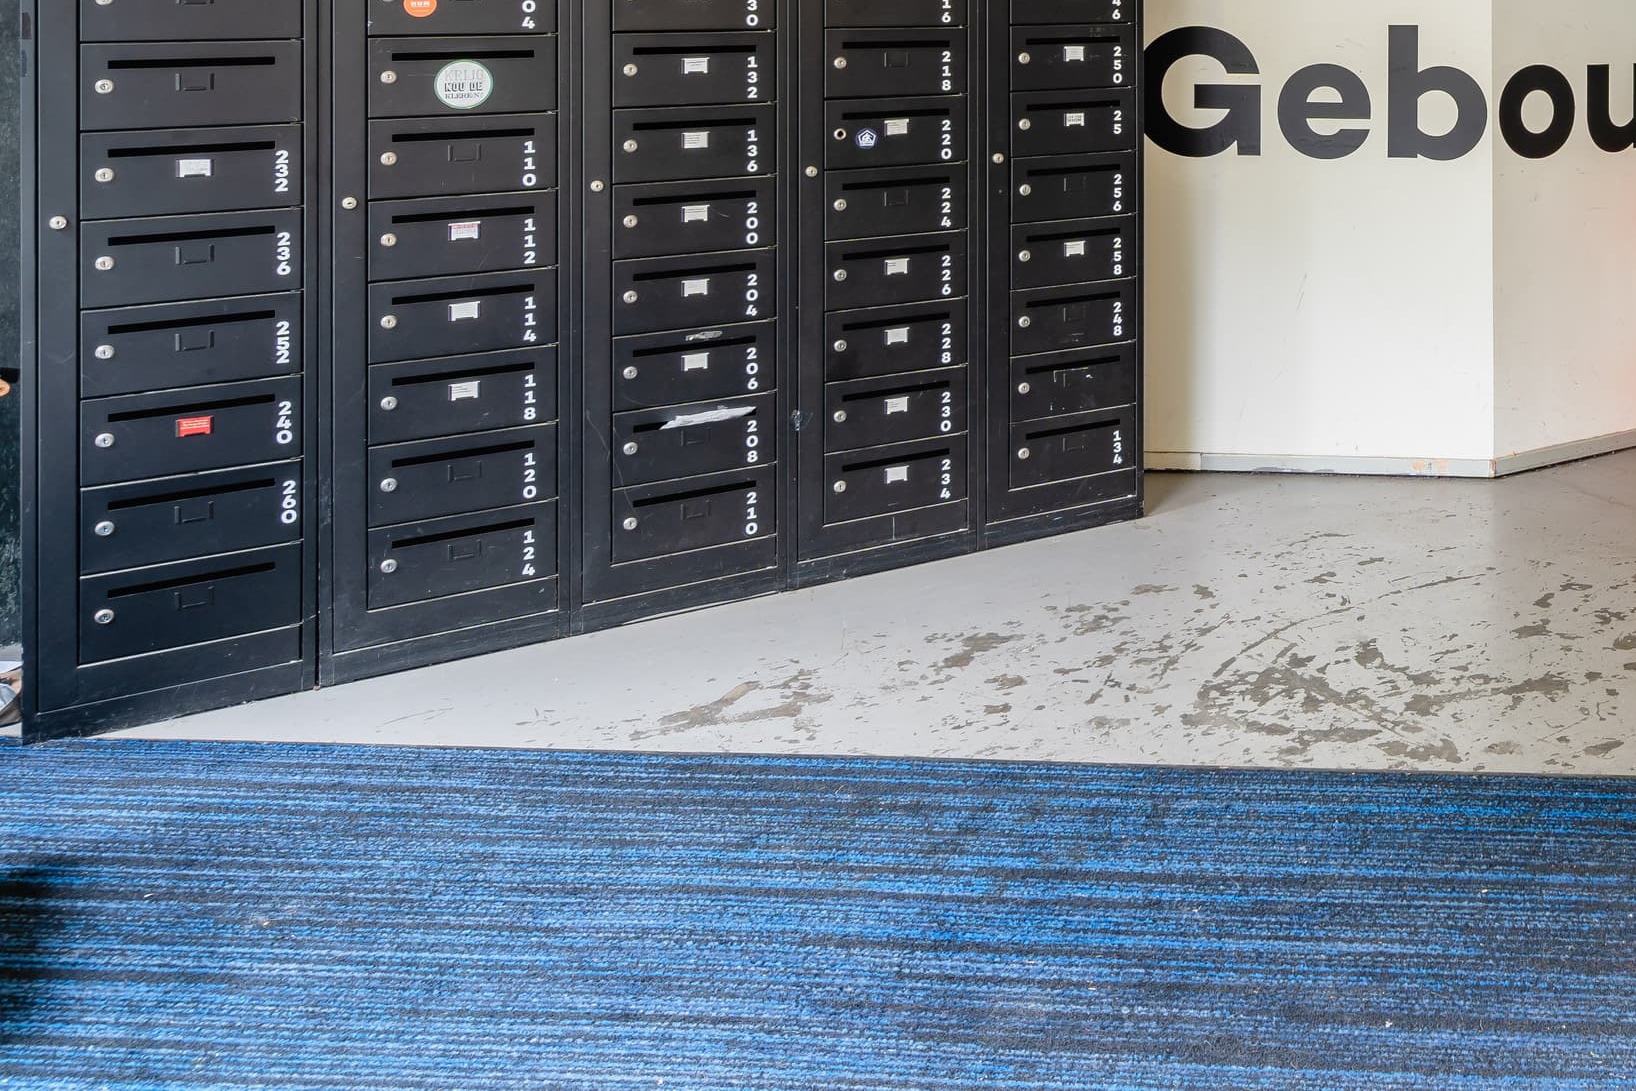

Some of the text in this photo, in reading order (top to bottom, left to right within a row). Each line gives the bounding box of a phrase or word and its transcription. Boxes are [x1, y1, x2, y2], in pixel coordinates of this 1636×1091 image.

[746, 55, 759, 99] 132
[941, 50, 952, 92] 218
[1112, 45, 1123, 84] 250
[746, 129, 759, 173] 136
[940, 119, 952, 160] 220
[274, 149, 289, 193] 232
[521, 140, 537, 187] 110
[940, 187, 952, 228] 224
[1112, 173, 1122, 212] 256
[523, 217, 537, 265] 112
[745, 201, 759, 245] 200
[275, 231, 292, 276] 236
[941, 254, 952, 296] 226
[1113, 237, 1123, 276] 258
[745, 273, 759, 317] 204
[522, 296, 537, 343] 114
[1112, 301, 1123, 337] 248
[275, 320, 291, 365] 252
[941, 323, 952, 364] 228
[745, 346, 759, 391] 206
[523, 373, 537, 421] 118
[940, 391, 952, 432] 230
[275, 400, 293, 445] 240
[745, 419, 759, 463] 208
[1112, 429, 1123, 465] 134
[522, 452, 537, 500] 120
[939, 458, 951, 500] 234
[280, 479, 298, 524] 260
[745, 491, 758, 535] 210
[521, 529, 536, 577] 124
